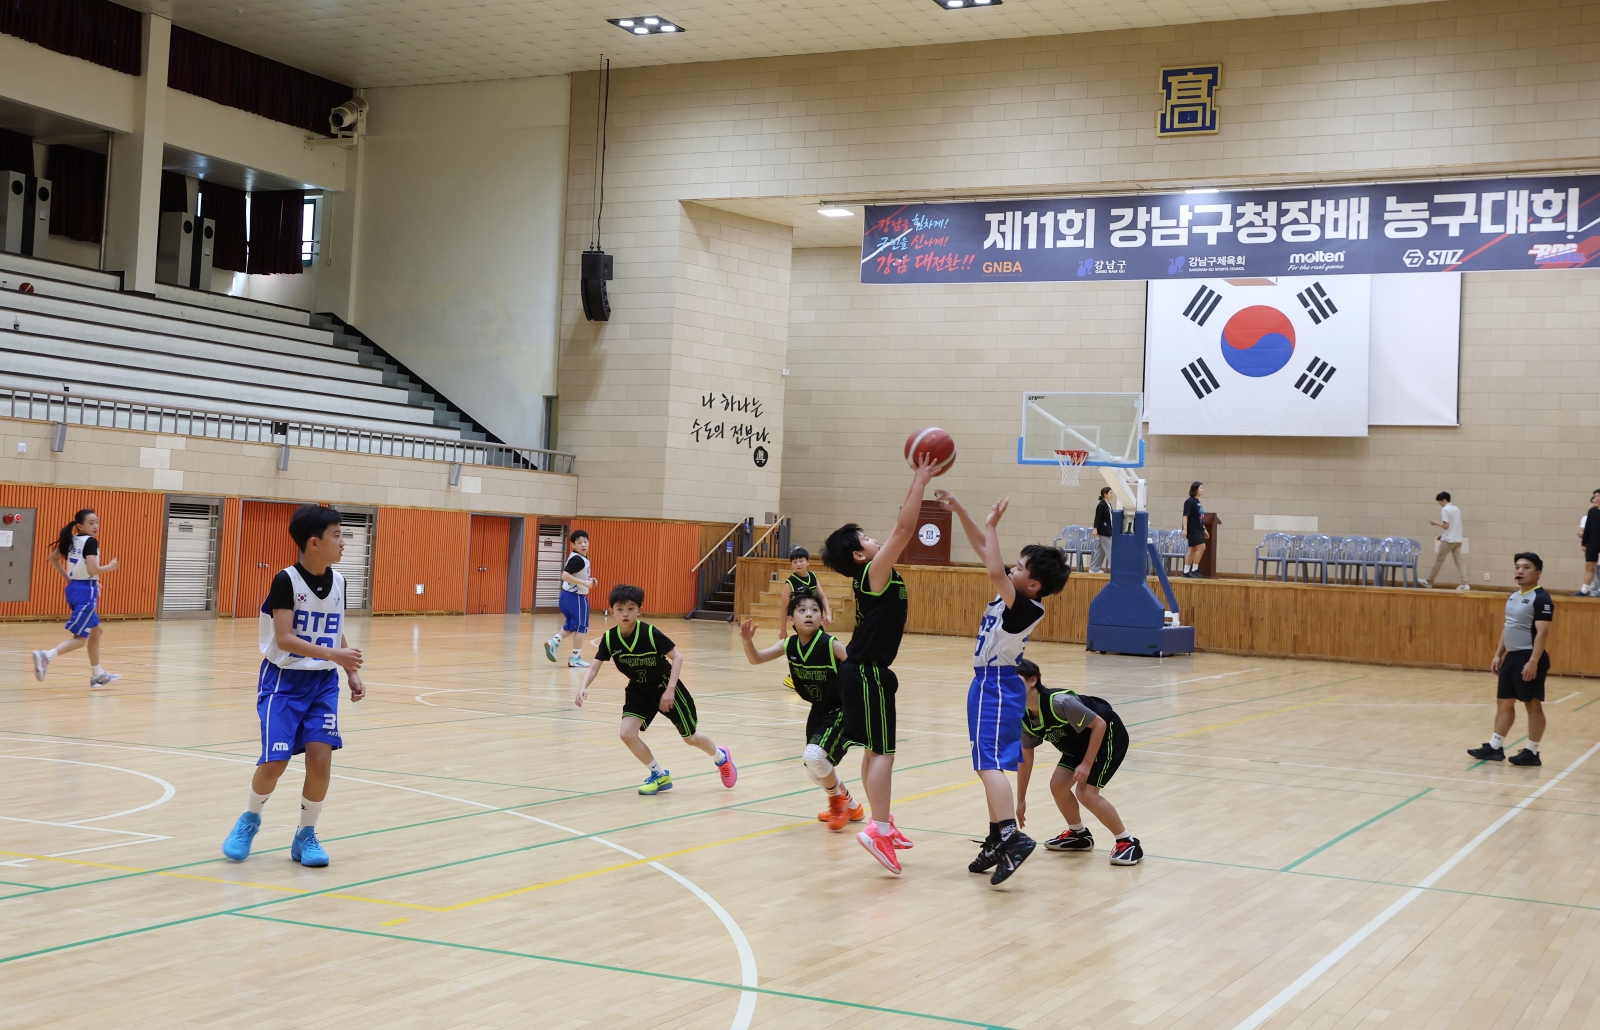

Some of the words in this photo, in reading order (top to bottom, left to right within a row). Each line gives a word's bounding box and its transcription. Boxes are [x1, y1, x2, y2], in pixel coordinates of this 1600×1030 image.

[912, 213, 950, 231] 힘차게!
[983, 208, 1096, 251] 제11회
[1109, 197, 1370, 248] 강남구청장배
[910, 233, 949, 249] 신나게!
[876, 252, 911, 275] 강남
[914, 251, 976, 272] 대전환!!
[1094, 259, 1127, 270] 강남구
[1188, 255, 1246, 267] 강남구체육회
[1289, 250, 1345, 263] molten
[1425, 249, 1464, 265] STIZ
[982, 261, 1023, 274] GNBA
[1324, 264, 1345, 272] game
[702, 392, 715, 409] 나
[720, 393, 764, 418] 하나는
[690, 418, 724, 443] 수도의
[292, 609, 341, 634] ATB
[271, 742, 289, 752] ATB
